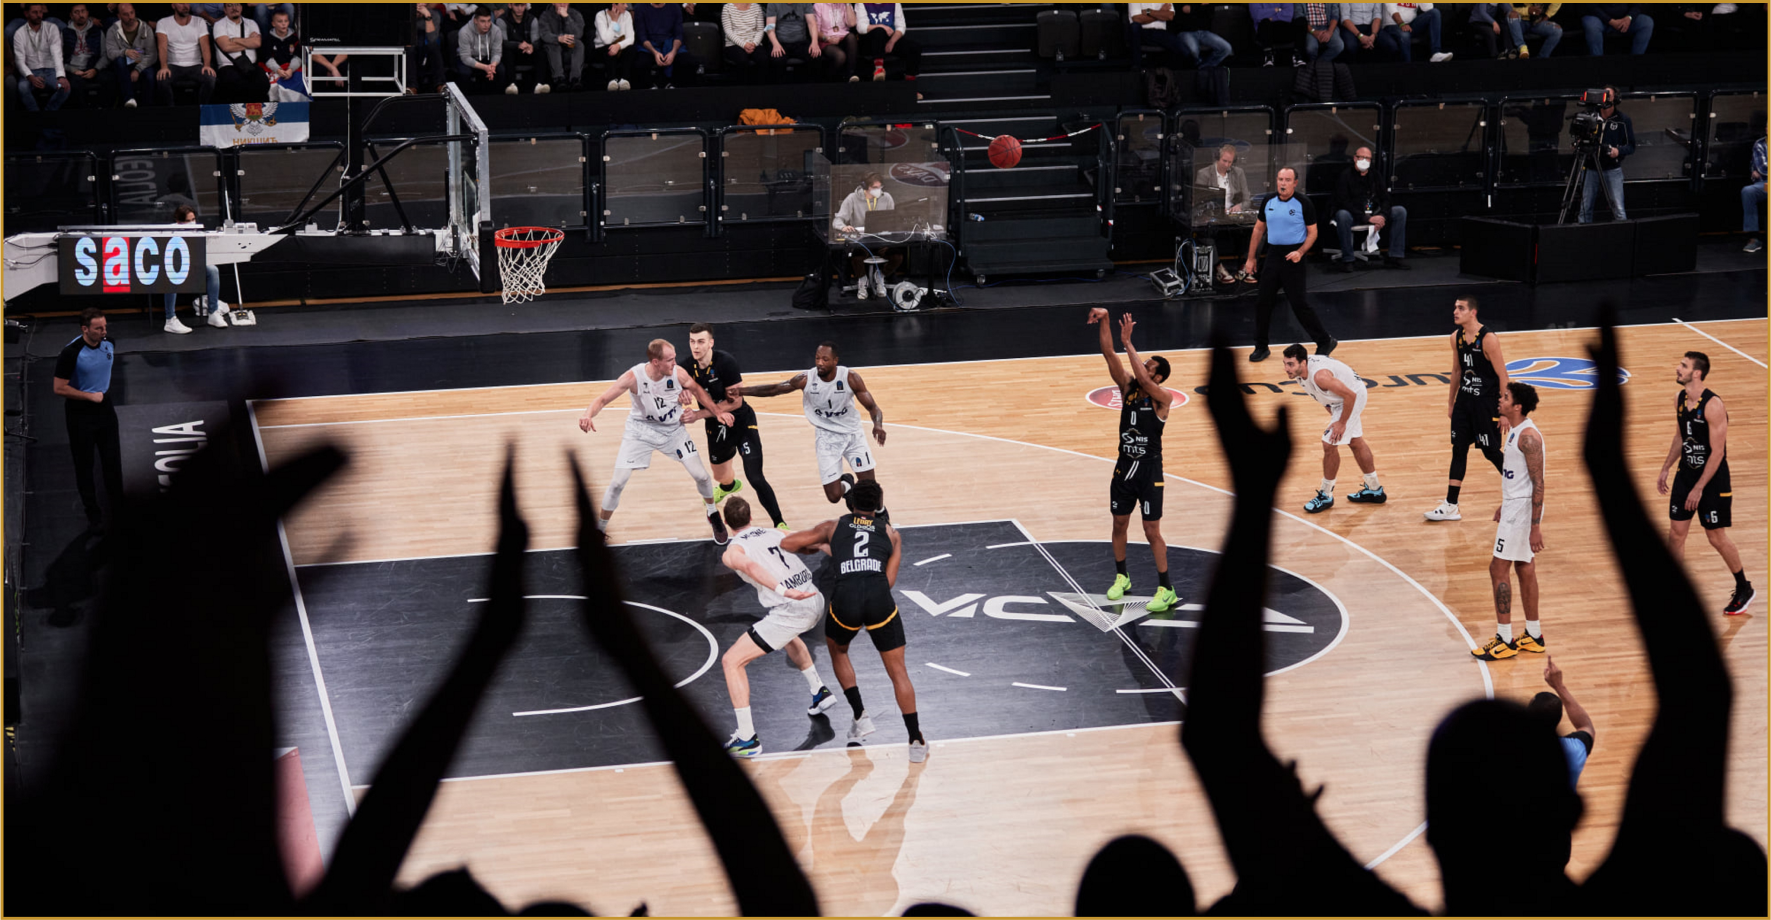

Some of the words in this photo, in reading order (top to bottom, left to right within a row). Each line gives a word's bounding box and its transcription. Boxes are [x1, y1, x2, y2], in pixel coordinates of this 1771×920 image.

[74, 236, 191, 287] saco
[1463, 353, 1473, 367] 41
[653, 396, 667, 410] 12
[827, 399, 832, 409] 1
[1130, 411, 1137, 425] 0
[684, 440, 697, 453] 12
[1479, 434, 1489, 447] 41
[743, 442, 751, 454] 5
[1122, 444, 1146, 455] mts
[865, 451, 871, 465] 1
[1143, 501, 1150, 515] 0
[1710, 511, 1718, 523] 6
[853, 531, 869, 557] 2
[1496, 538, 1505, 553] 5
[767, 546, 790, 570] 7
[840, 557, 882, 575] BELGRADE
[780, 569, 812, 589] AMBURG
